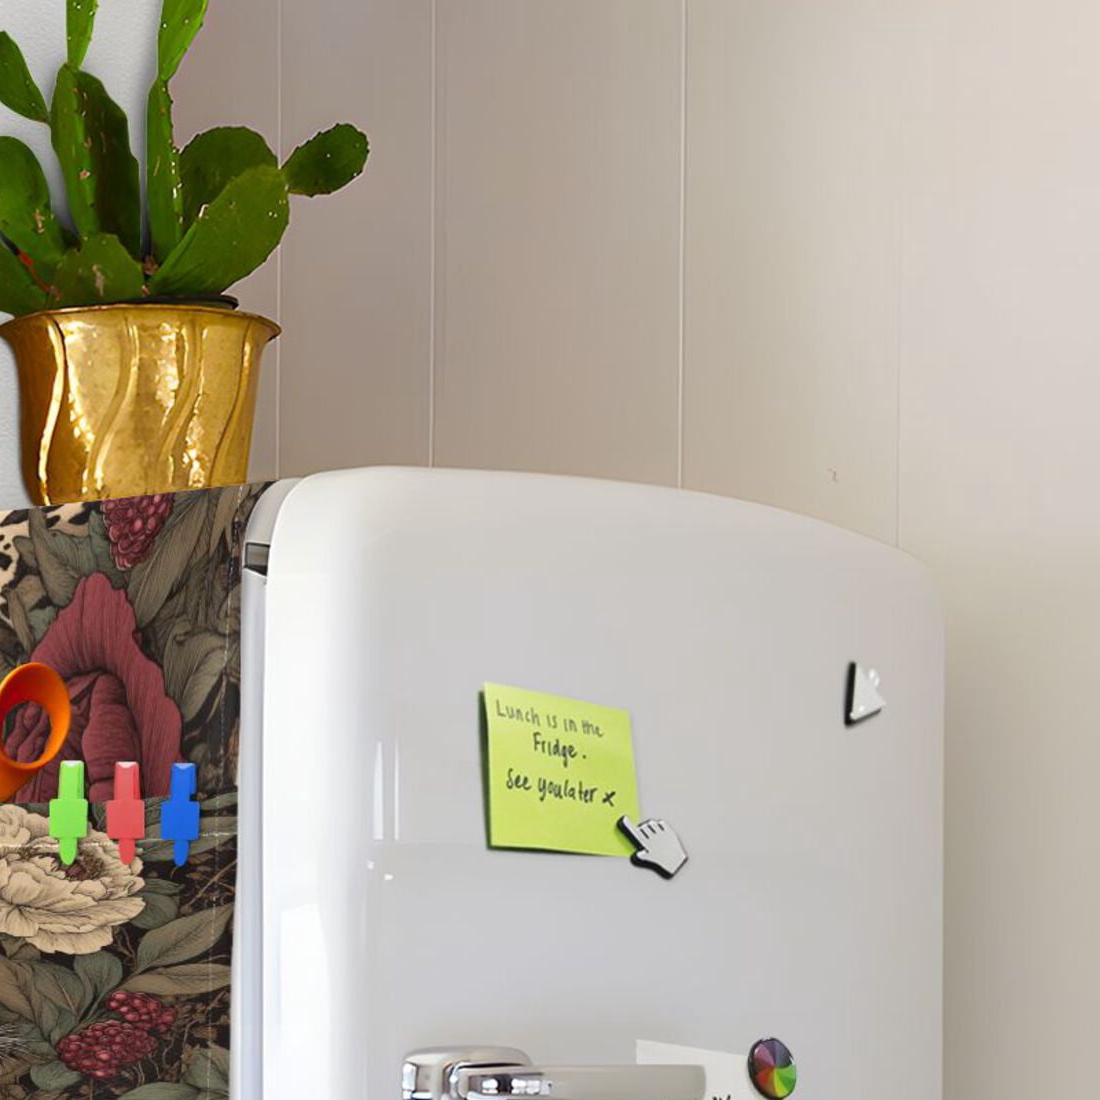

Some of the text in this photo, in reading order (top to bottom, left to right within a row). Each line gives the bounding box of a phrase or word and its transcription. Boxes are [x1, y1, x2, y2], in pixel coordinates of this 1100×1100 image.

[496, 700, 541, 727] Lunch
[564, 718, 578, 733] in
[582, 719, 604, 738] the
[506, 768, 532, 790] See
